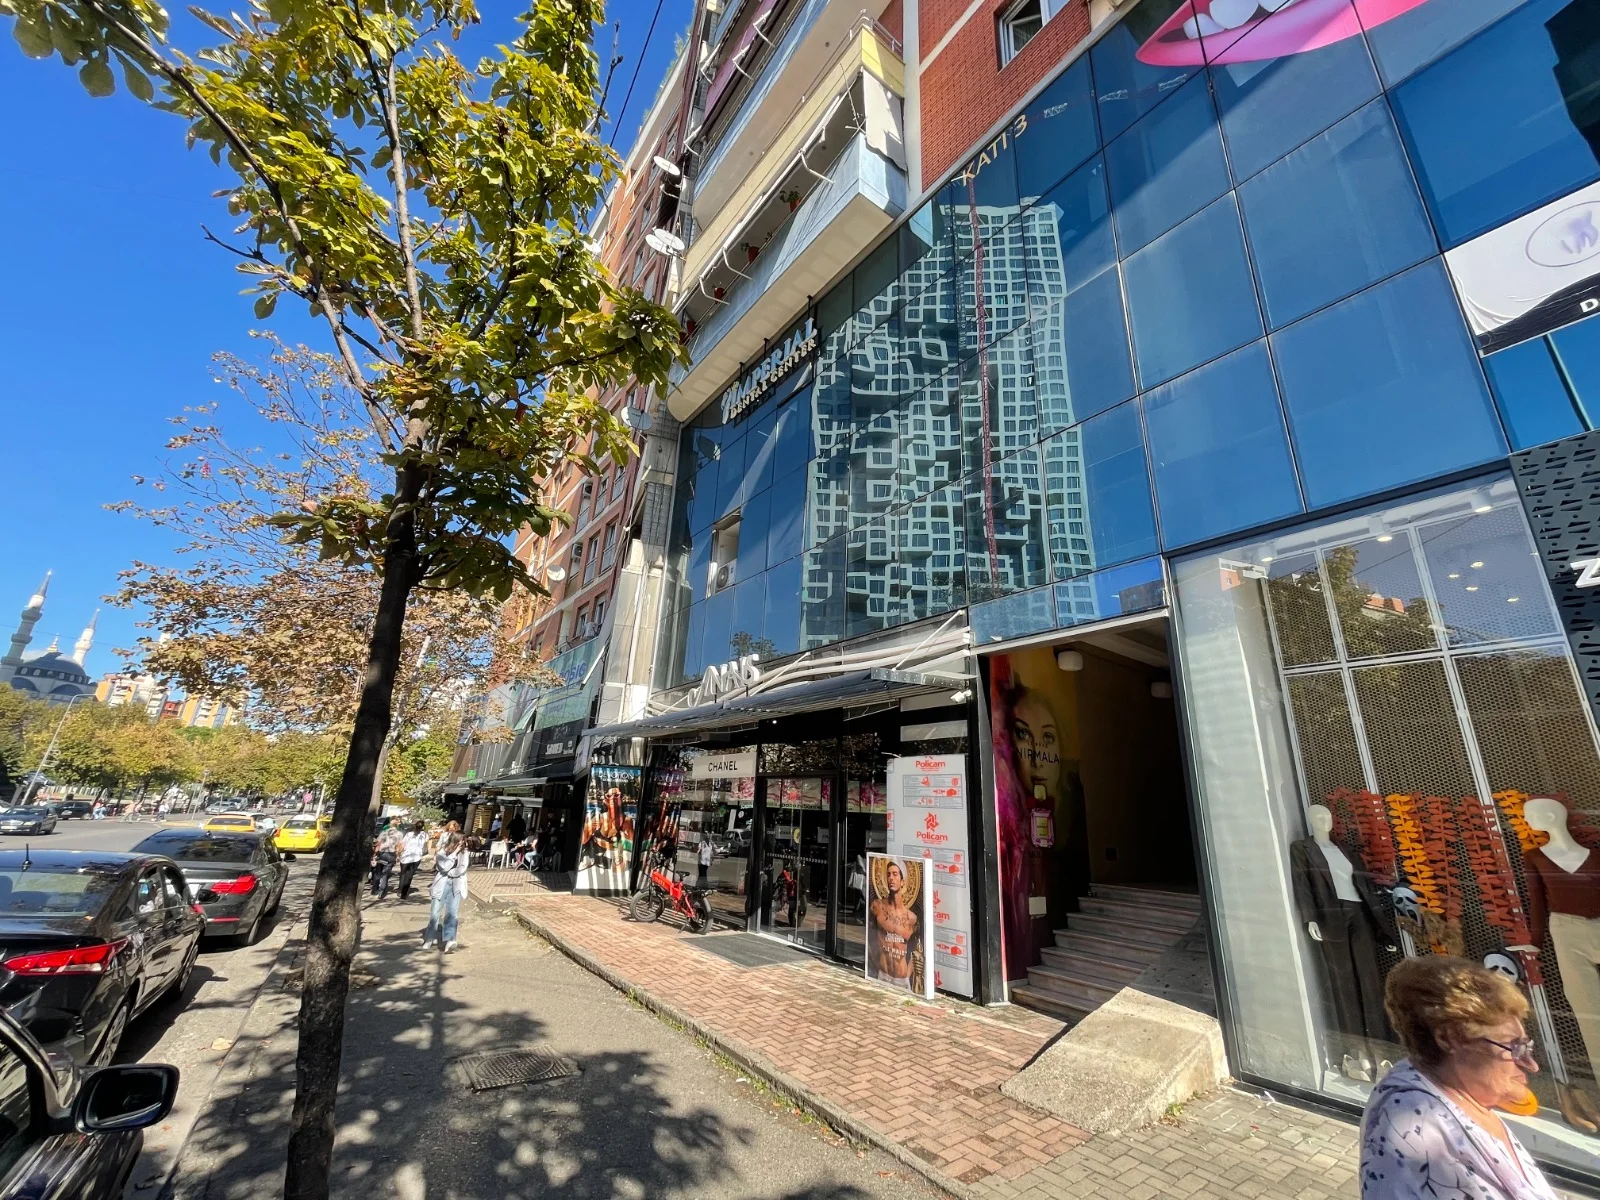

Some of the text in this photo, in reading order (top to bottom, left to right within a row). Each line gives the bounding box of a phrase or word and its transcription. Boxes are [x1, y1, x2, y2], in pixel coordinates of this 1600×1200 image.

[962, 114, 1028, 187] KATI 3
[730, 338, 817, 419] DENTAL CENTER
[1016, 748, 1060, 764] NIRMALA
[707, 760, 738, 772] CHANEL
[915, 760, 946, 768] Policam
[916, 831, 948, 841] Policam
